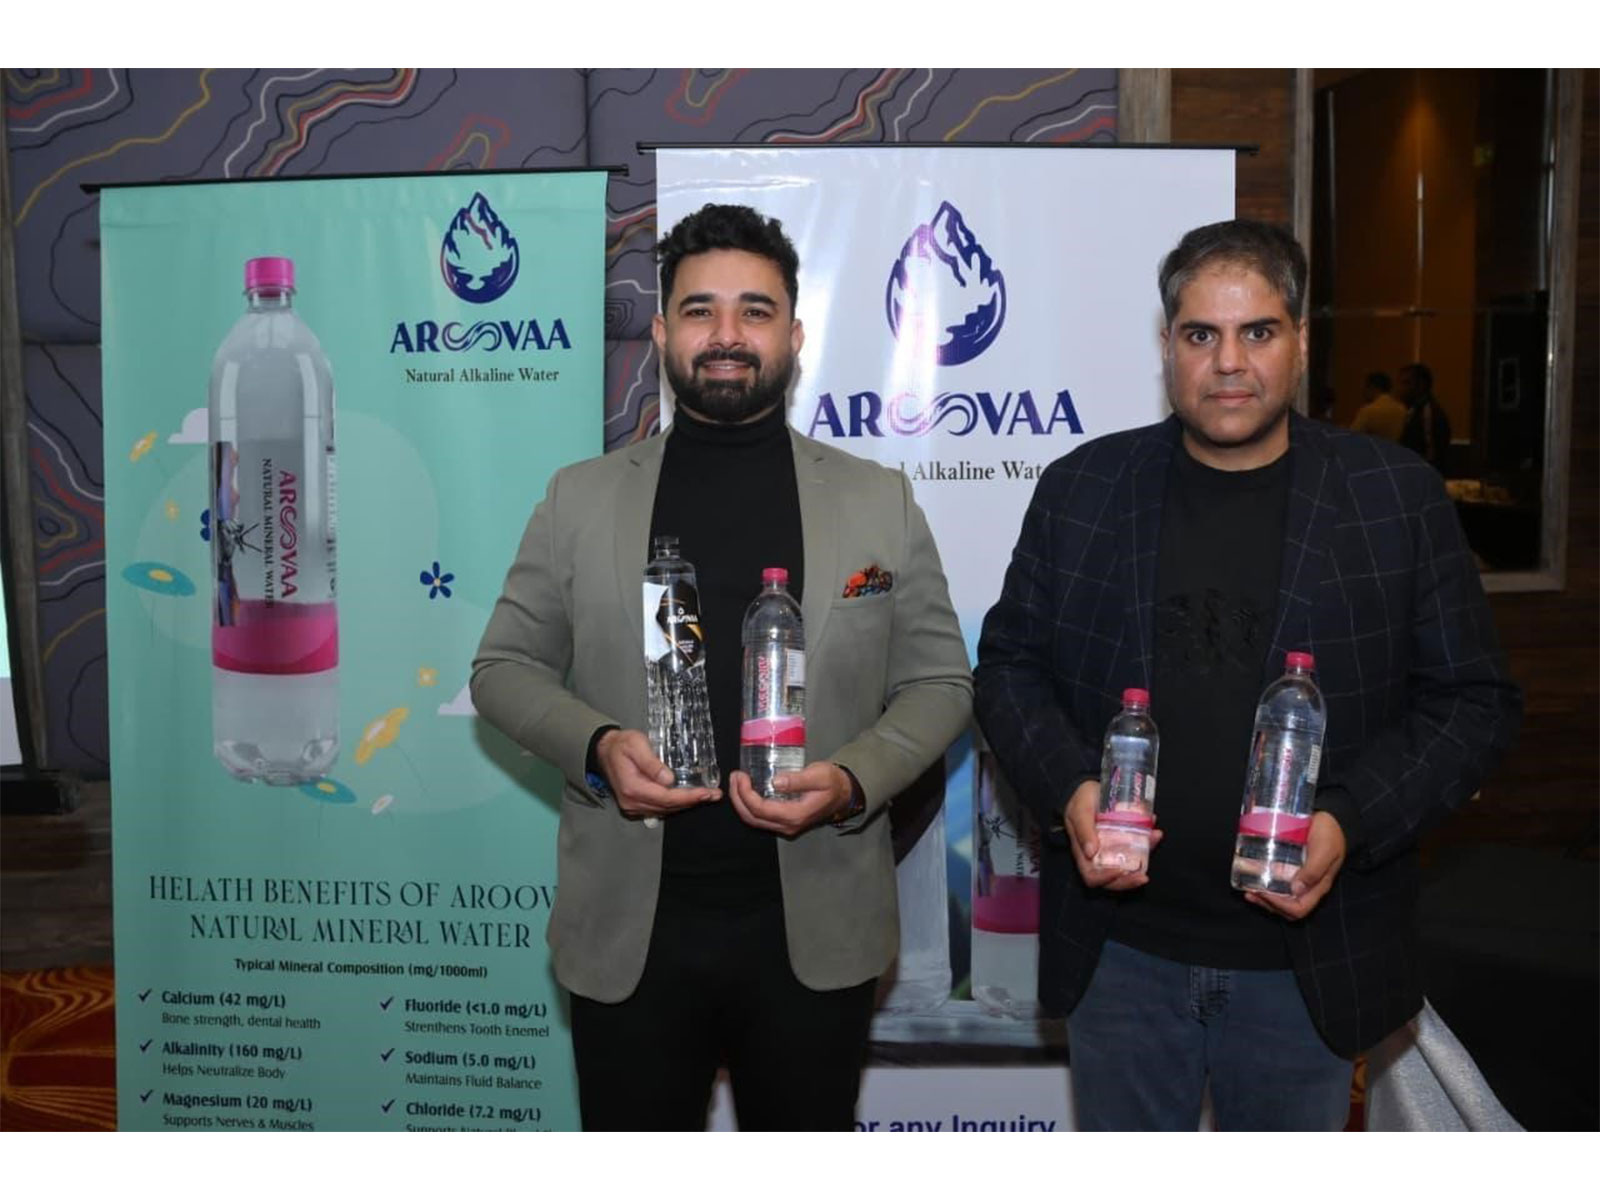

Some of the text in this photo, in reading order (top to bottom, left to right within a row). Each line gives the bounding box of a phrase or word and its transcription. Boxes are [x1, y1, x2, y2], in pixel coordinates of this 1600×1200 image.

[406, 367, 559, 383] Natural Alkaline Water
[912, 461, 996, 481] Alkaline
[1001, 461, 1043, 480] Wat
[262, 458, 275, 608] NATURAL MINERAL WATER
[150, 875, 557, 911] HELATH BENEFITS OF AROOV
[190, 913, 531, 949] NATURAL MINERAL WATER
[234, 958, 488, 978] Typical Mineral Composition (mg/1000ml)
[162, 990, 286, 1009] Calcium (42 mg/L)
[405, 998, 547, 1018] Fluoride (<1.0 mg/L)
[162, 1012, 321, 1029] Bone strength, dental health
[470, 1023, 502, 1036] Tooth
[162, 1041, 302, 1061] Alkalinity (160 mg/L)
[405, 1050, 536, 1071] Sodium (5.0 mg/L)
[162, 1063, 286, 1080] Helps Neutralize Body
[405, 1073, 542, 1090] Maintains Fluid Balance
[163, 1093, 312, 1113] Magnesium (20 mg/L)
[406, 1102, 541, 1122] Chloride (7.2 mg/L)
[163, 1113, 315, 1131] Supports Nerves & Muscles
